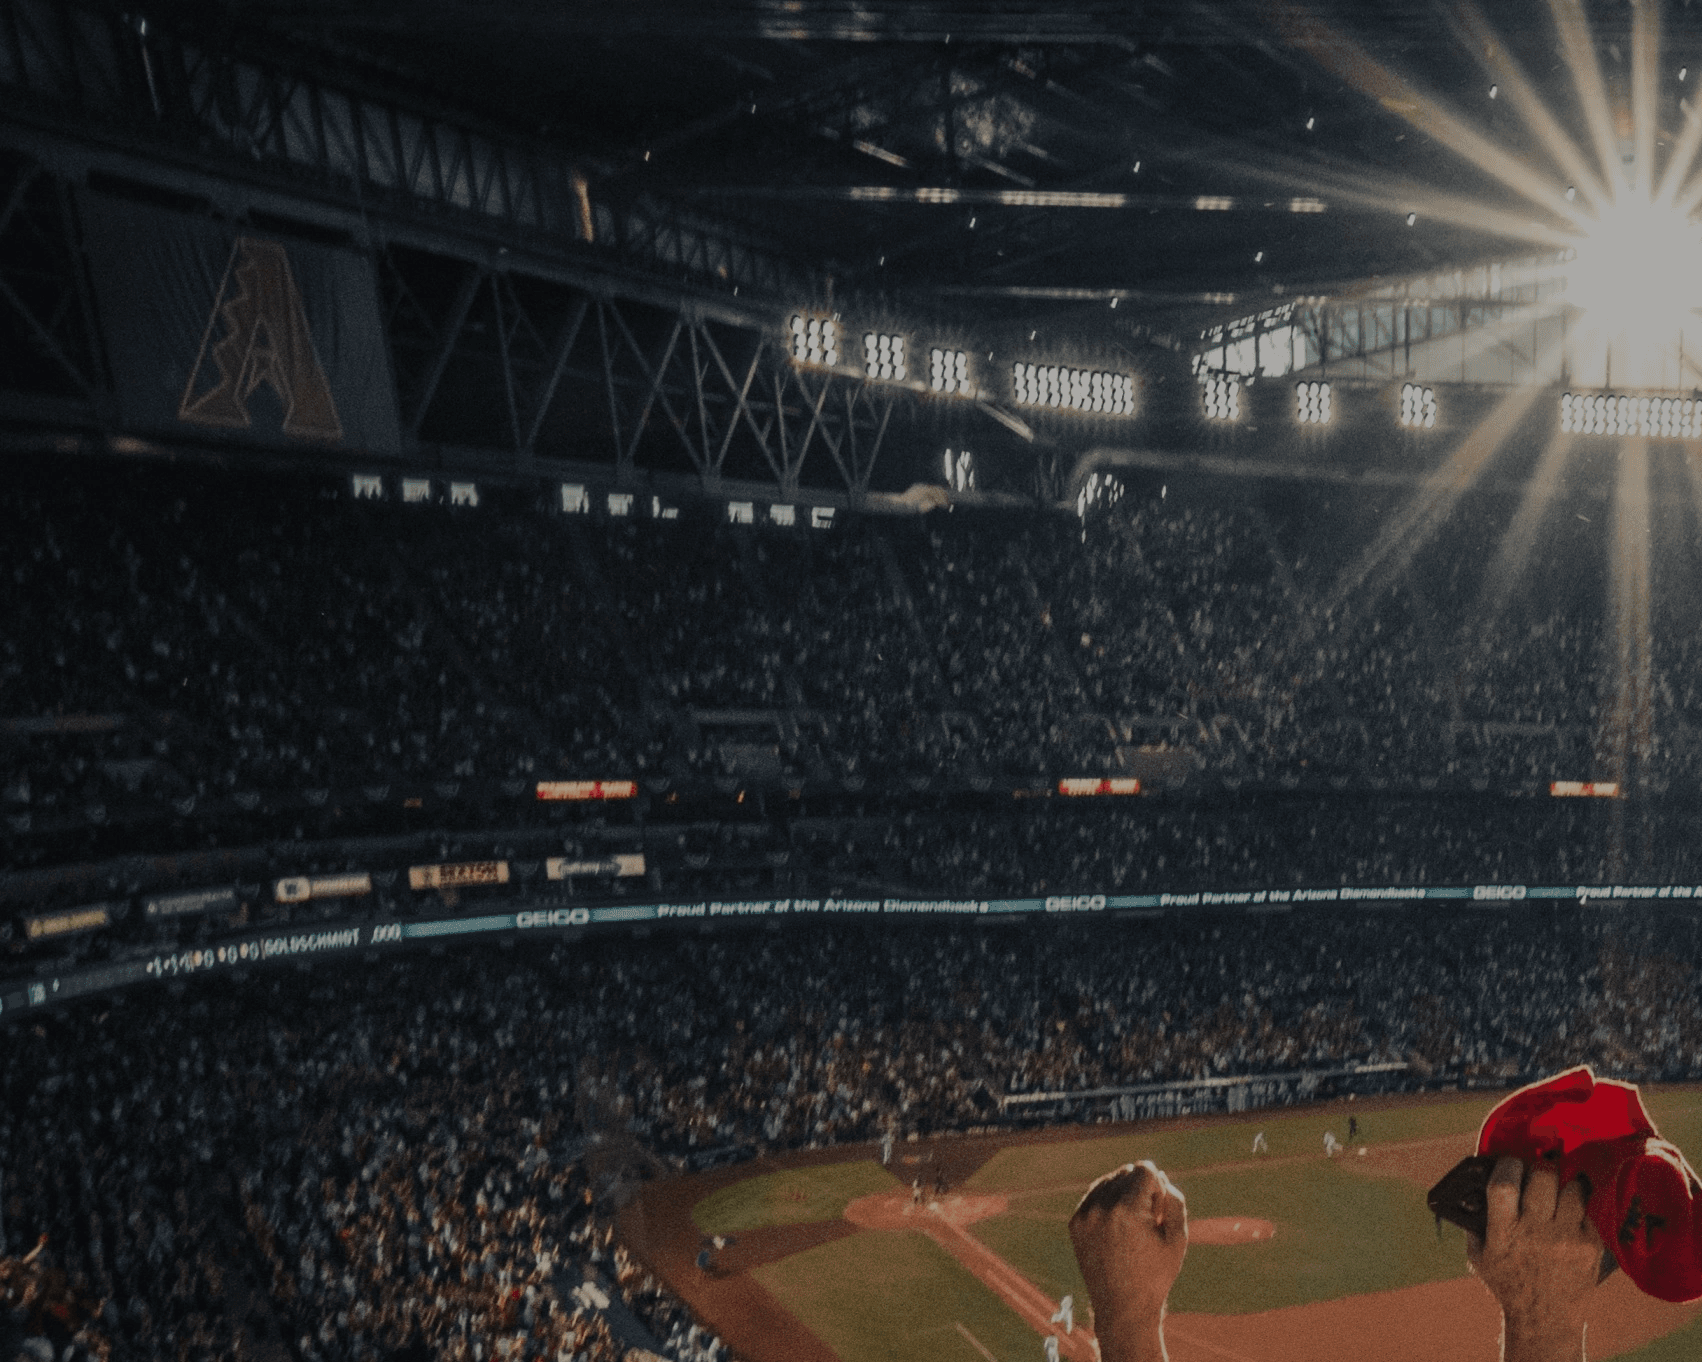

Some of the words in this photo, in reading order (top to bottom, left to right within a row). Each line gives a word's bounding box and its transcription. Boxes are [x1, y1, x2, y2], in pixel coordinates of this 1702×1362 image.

[1160, 893, 1200, 907] Proud
[1202, 891, 1251, 906] Partner
[1292, 888, 1338, 902] Arizona
[1472, 885, 1527, 900] GEICO
[657, 901, 706, 918] Proud
[710, 900, 770, 916] Partner
[774, 898, 791, 914] of
[793, 898, 820, 913] the
[823, 898, 880, 913] Arizona
[1045, 895, 1106, 912] GEICO
[516, 907, 589, 929] GEICO
